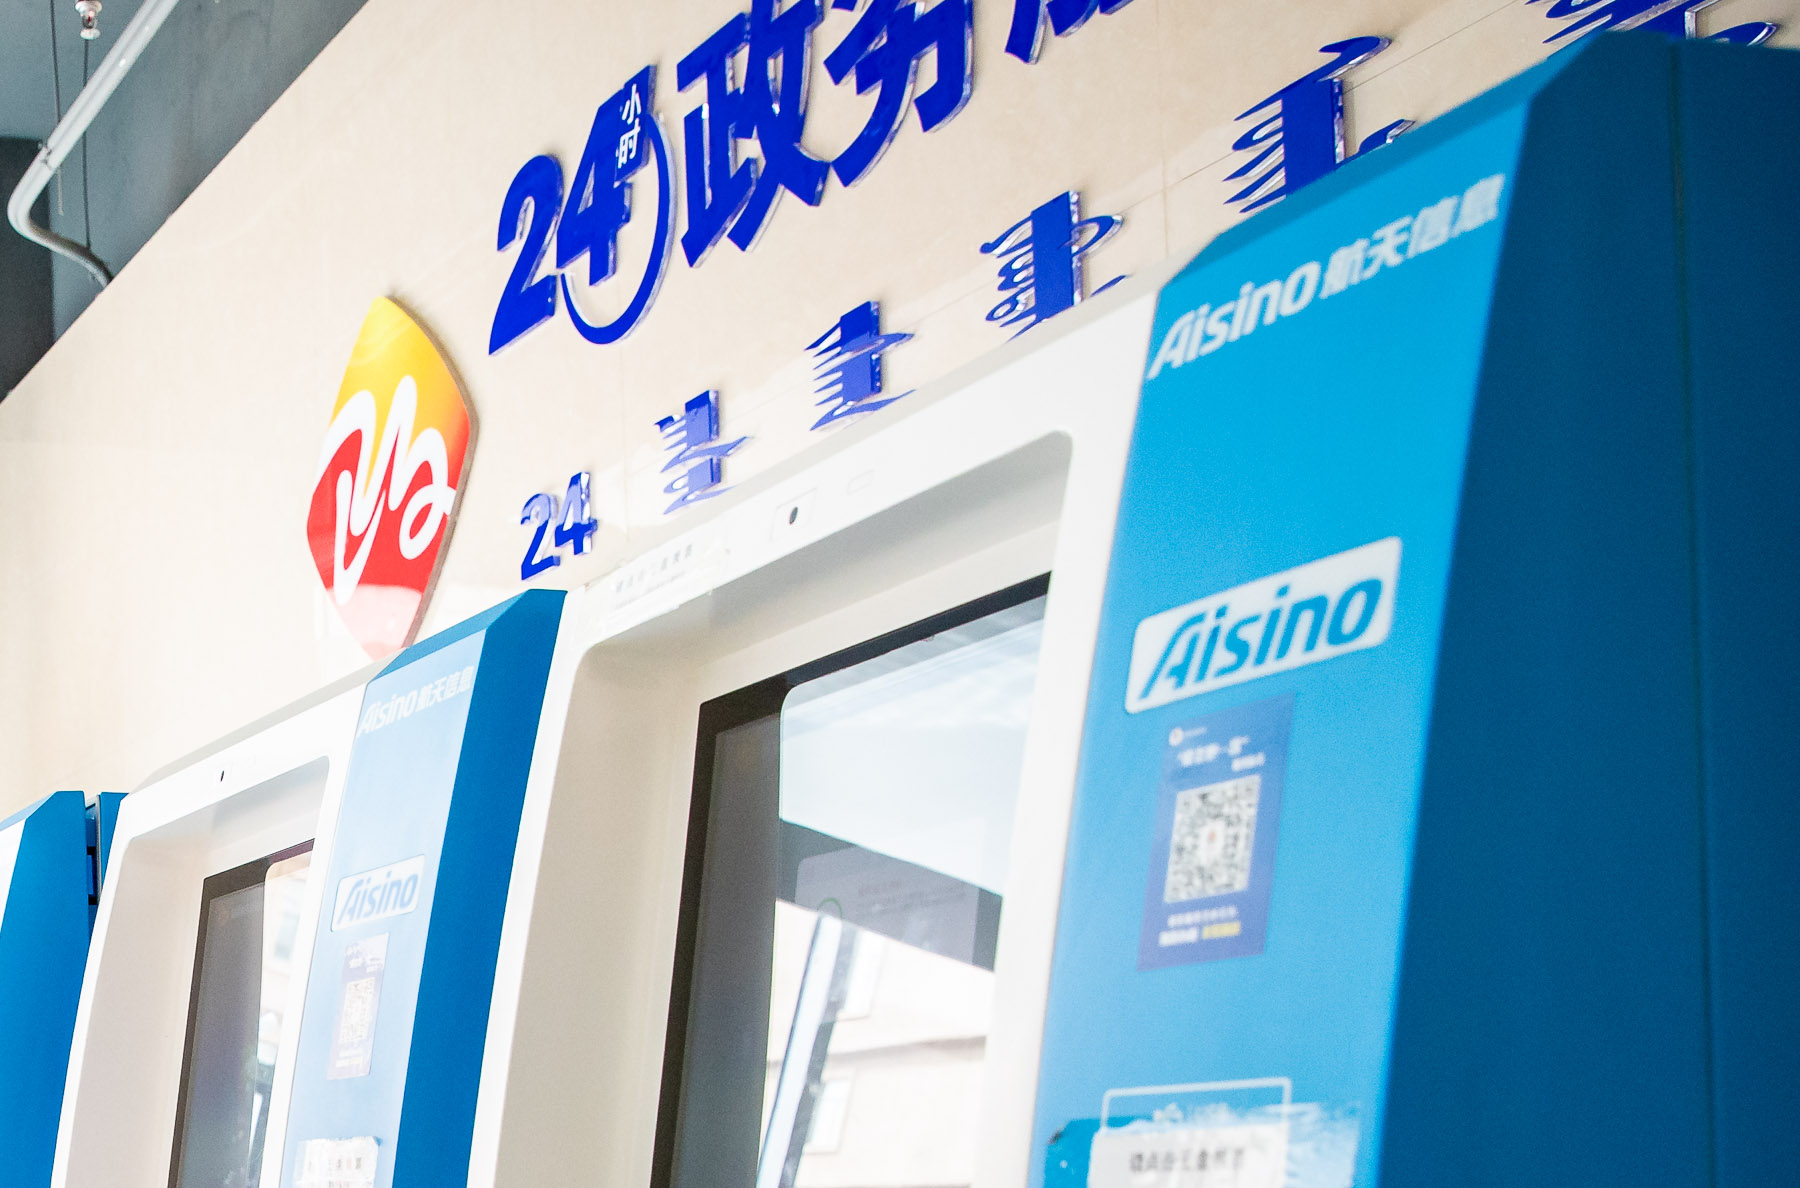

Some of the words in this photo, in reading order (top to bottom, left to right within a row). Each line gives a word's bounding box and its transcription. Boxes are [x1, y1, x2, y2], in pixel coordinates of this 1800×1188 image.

[1146, 261, 1322, 380] Aisino
[1319, 172, 1506, 299] 航天信息
[519, 471, 599, 581] 24
[1138, 578, 1384, 700] Aisino
[356, 689, 419, 738] Aisino
[336, 870, 419, 925] Aisino
